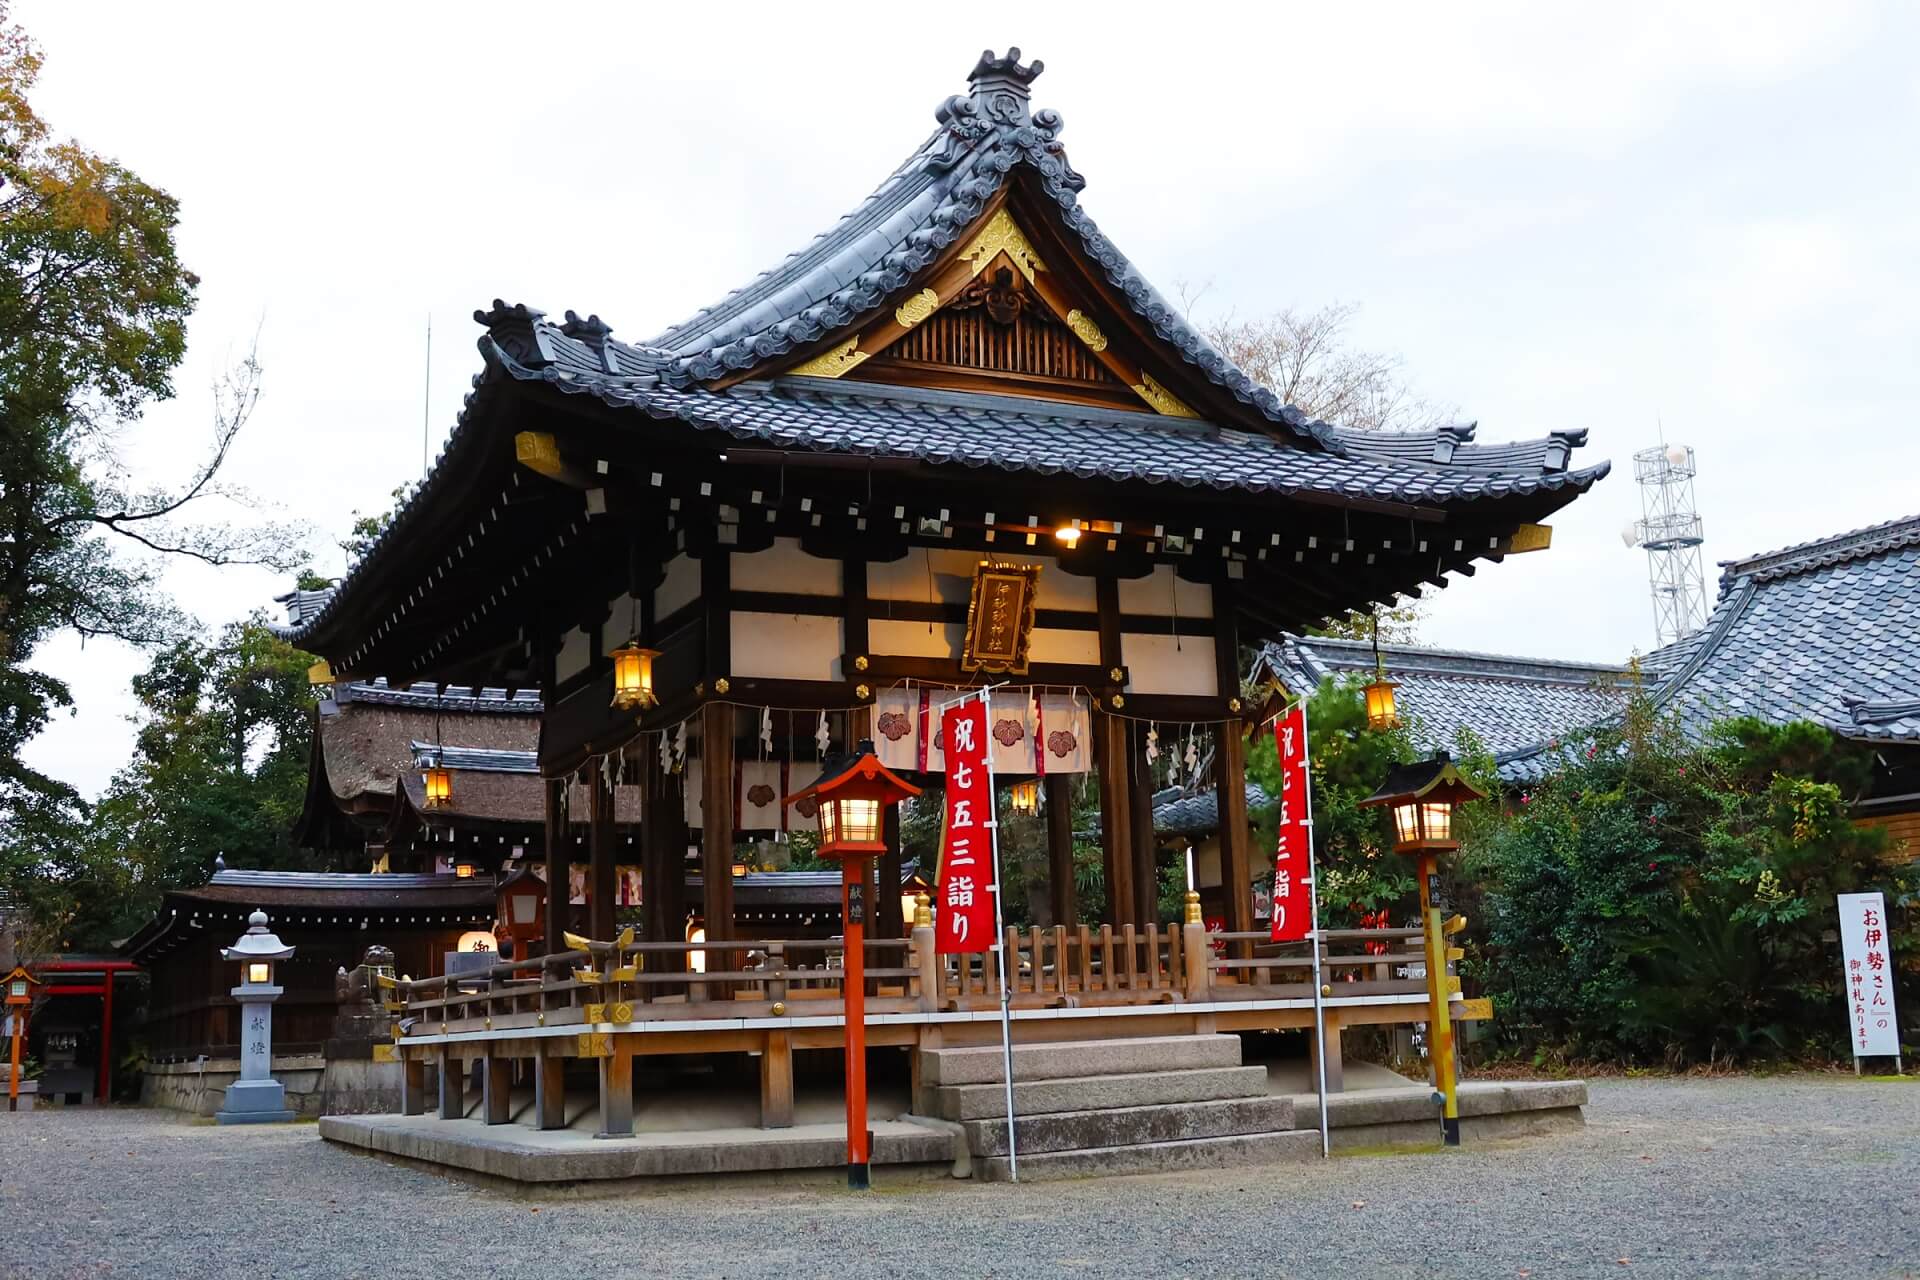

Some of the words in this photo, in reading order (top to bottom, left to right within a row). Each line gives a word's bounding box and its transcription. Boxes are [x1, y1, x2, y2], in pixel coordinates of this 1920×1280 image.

[947, 717, 976, 944] 祝七五三詣り
[1849, 959, 1869, 1050] 御神札あります
[1860, 899, 1891, 1029] 『お伊勢さん』の
[249, 1016, 266, 1055] 献燈
